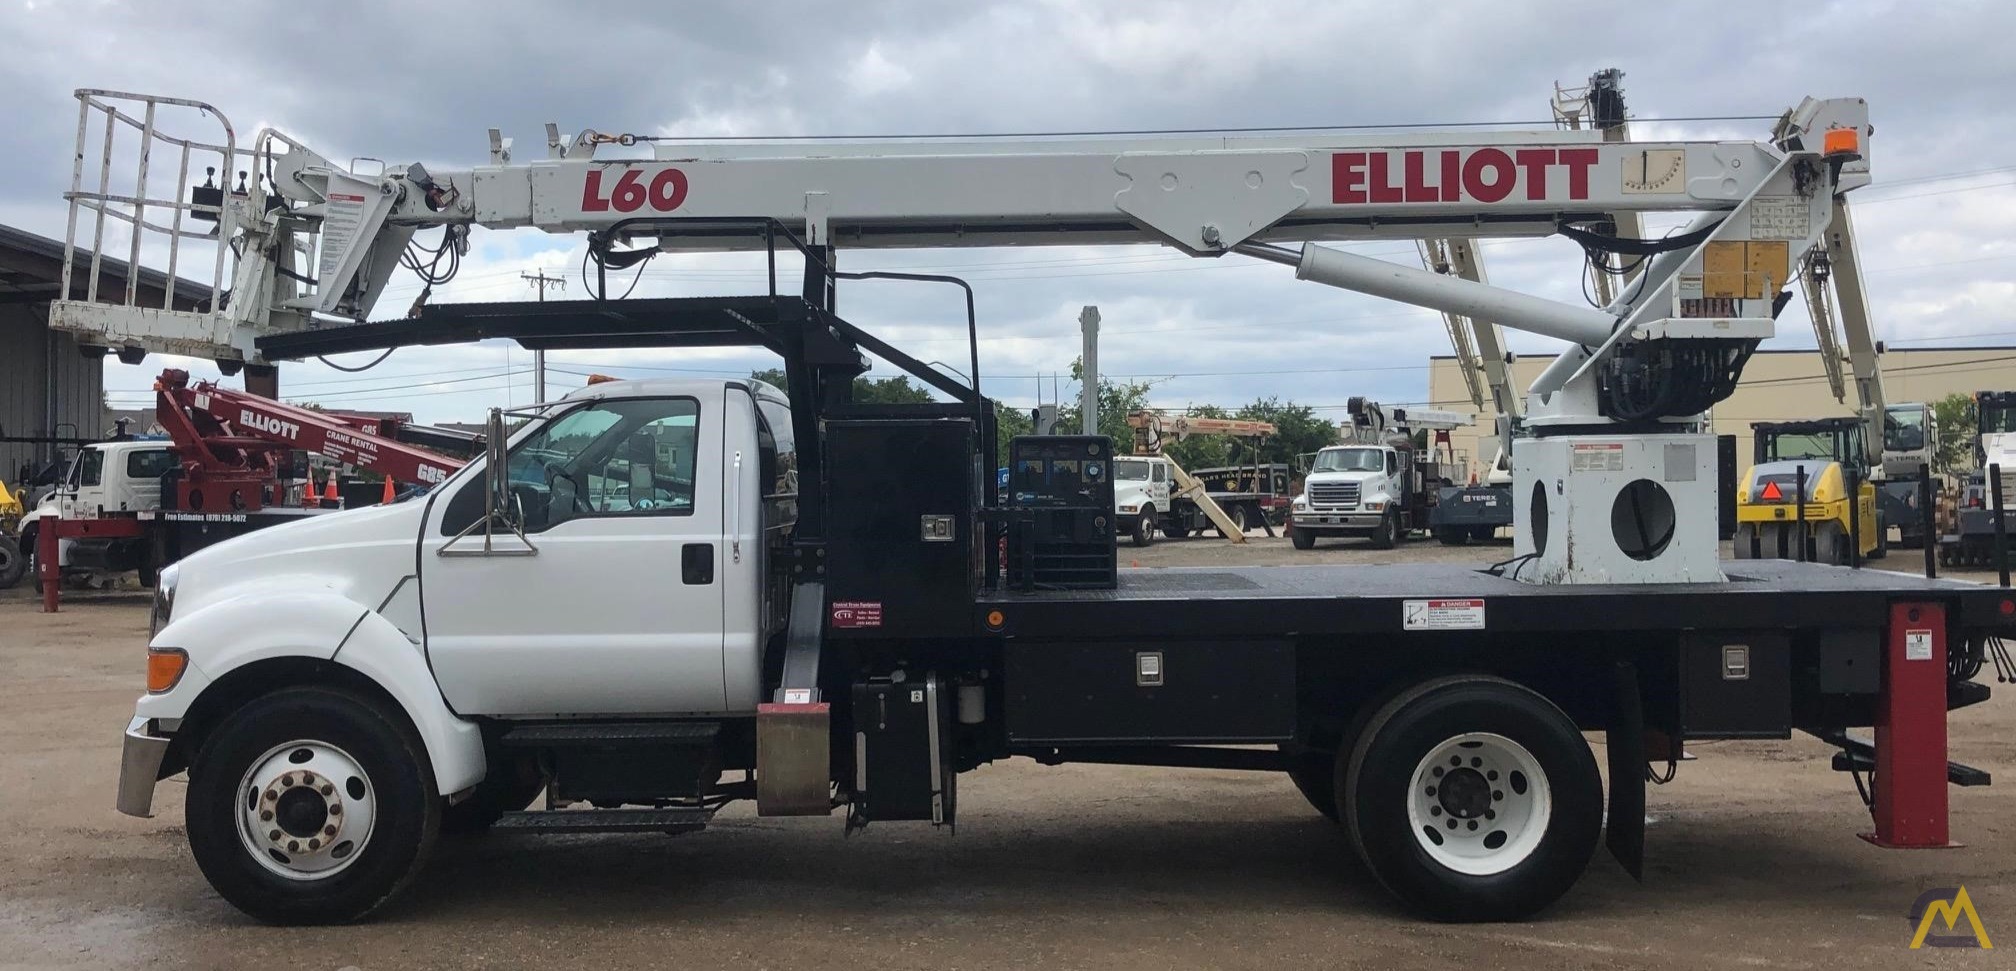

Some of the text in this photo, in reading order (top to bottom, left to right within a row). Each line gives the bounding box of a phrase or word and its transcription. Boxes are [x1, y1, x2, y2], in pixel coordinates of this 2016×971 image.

[1332, 148, 1598, 203] ELLIOTT
[581, 168, 689, 213] L60
[240, 409, 300, 441] ELLIOTT
[326, 430, 350, 444] CRANE
[351, 437, 379, 453] RENTAL
[417, 463, 447, 484] G85
[165, 513, 177, 521] Free
[177, 513, 204, 522] Estimates
